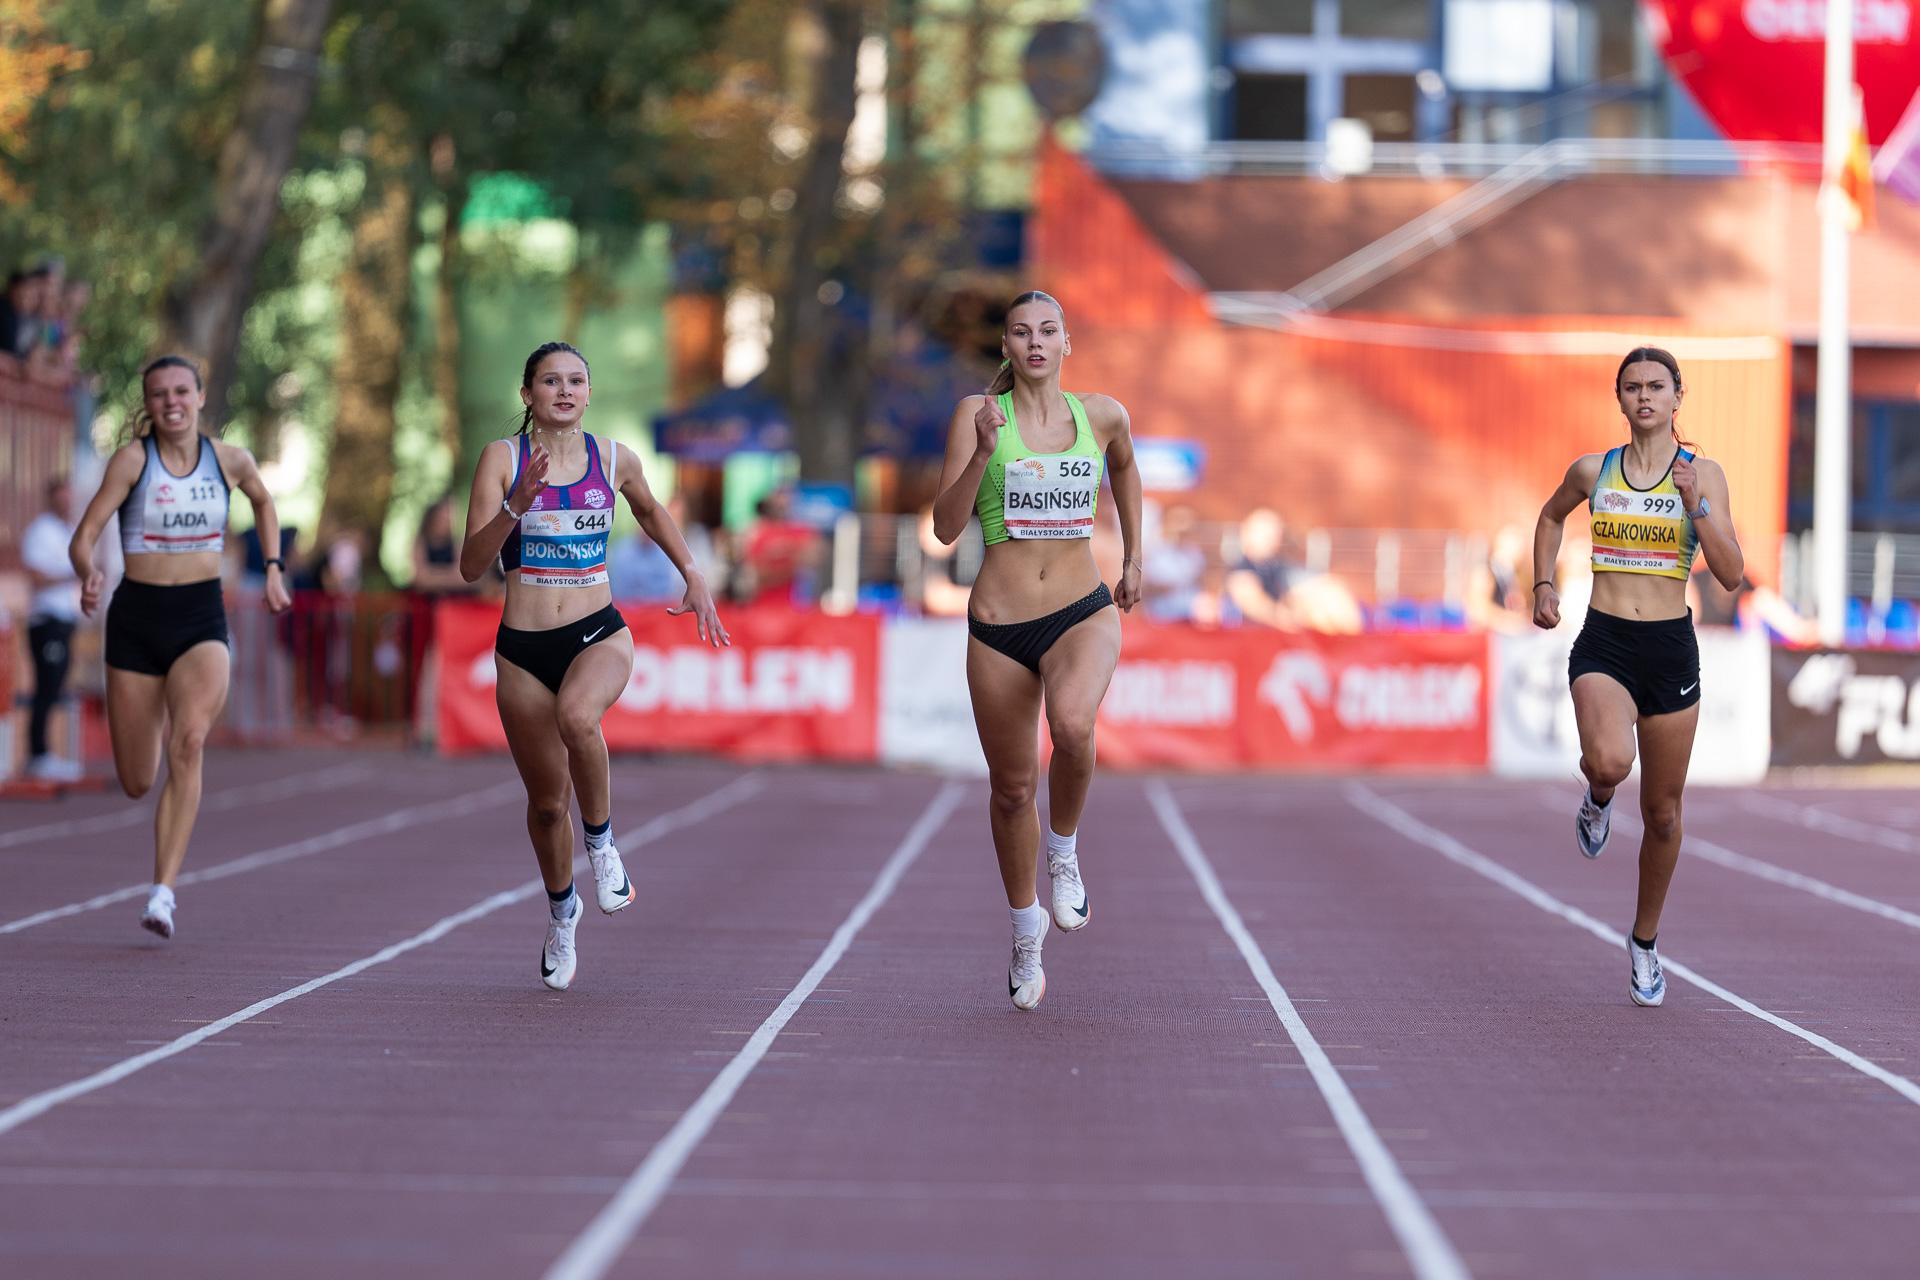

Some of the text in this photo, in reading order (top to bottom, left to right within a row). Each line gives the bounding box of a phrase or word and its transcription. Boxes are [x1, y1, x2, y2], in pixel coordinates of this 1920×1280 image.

[1060, 461, 1091, 477] 562
[190, 485, 216, 500] 111
[584, 494, 607, 505] AMS
[1009, 488, 1090, 509] BASIŃSKA
[1643, 498, 1675, 513] 999
[163, 512, 208, 528] LADA
[574, 514, 606, 530] 644
[1593, 521, 1676, 543] CZAJKOWSKA
[525, 539, 604, 560] BOROWSKA
[1604, 556, 1642, 566] BIAŁYSTOK
[536, 576, 596, 585] BIAŁYSTOK 2024
[617, 644, 854, 716] ORLEN
[1335, 662, 1483, 731] ORLEN
